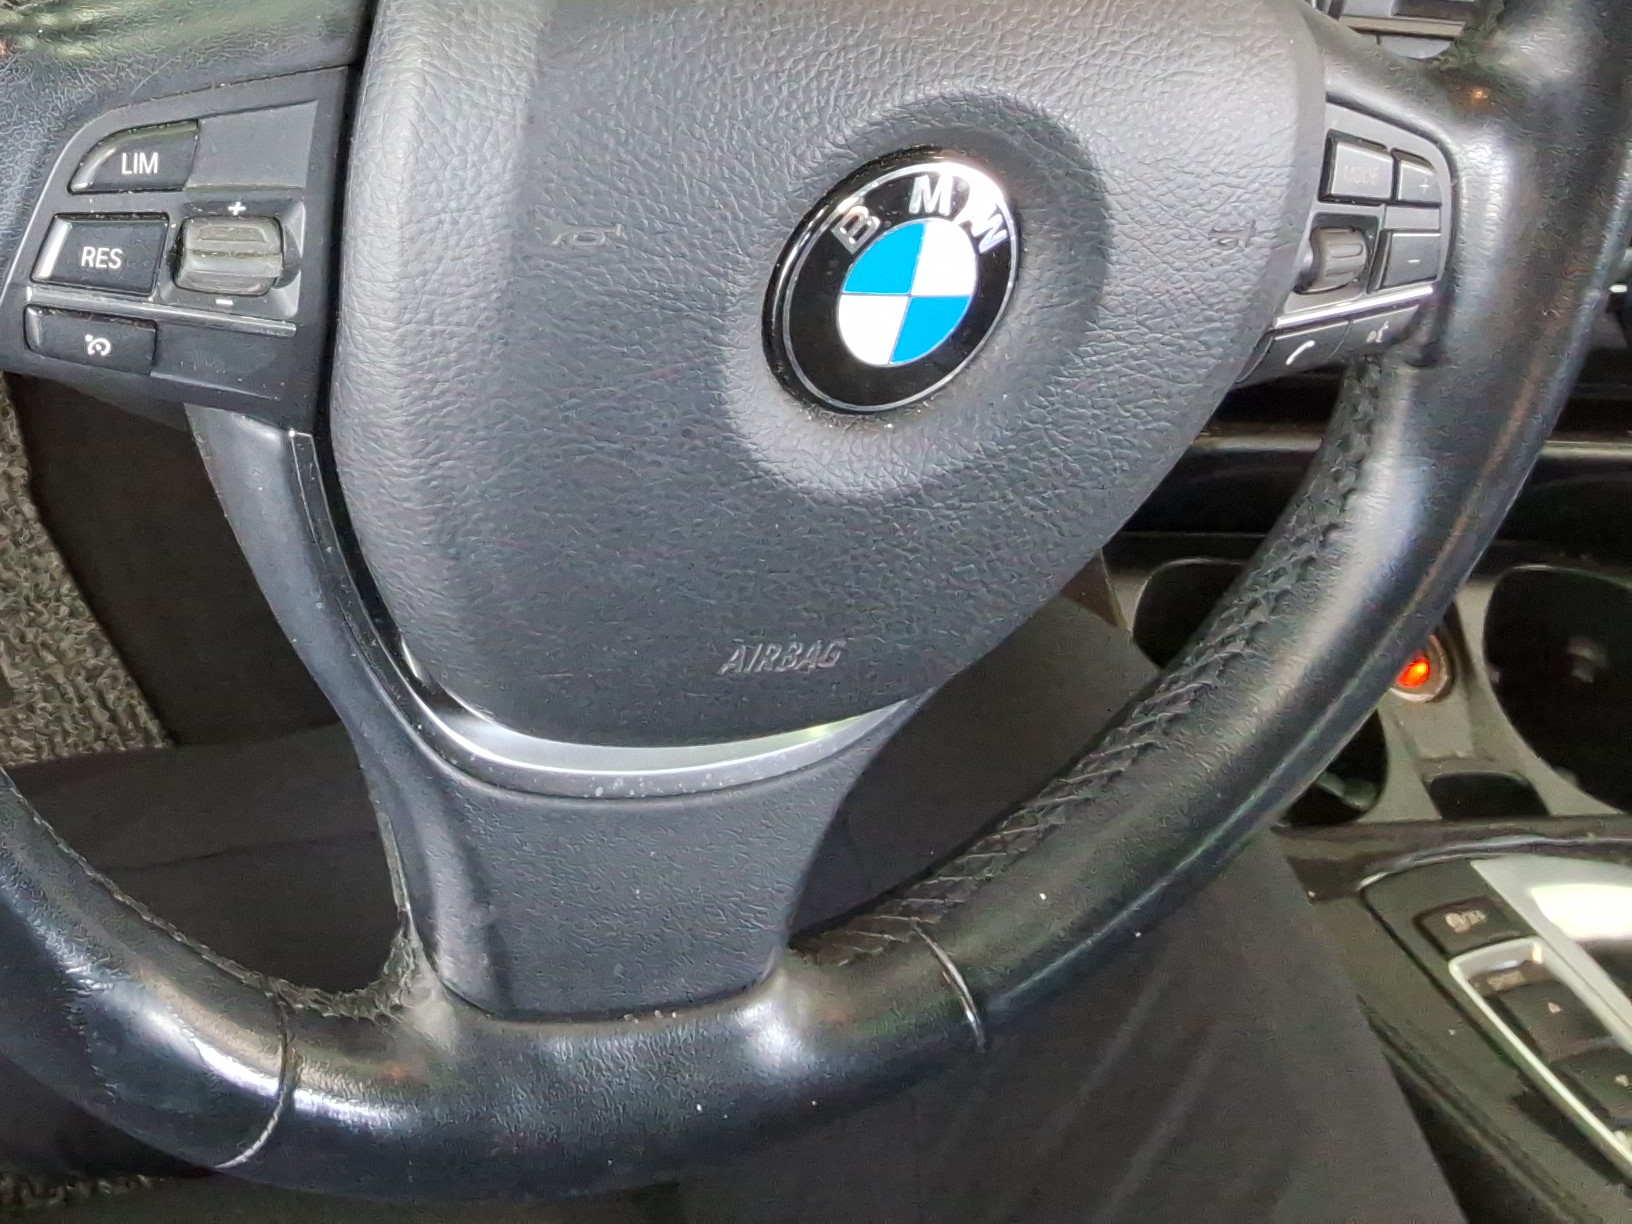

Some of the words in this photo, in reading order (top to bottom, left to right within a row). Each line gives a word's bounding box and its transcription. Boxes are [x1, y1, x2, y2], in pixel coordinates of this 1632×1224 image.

[121, 153, 159, 175] LIM
[831, 174, 1008, 254] BMW
[81, 246, 123, 269] RES
[719, 640, 843, 674] AIRBAG
